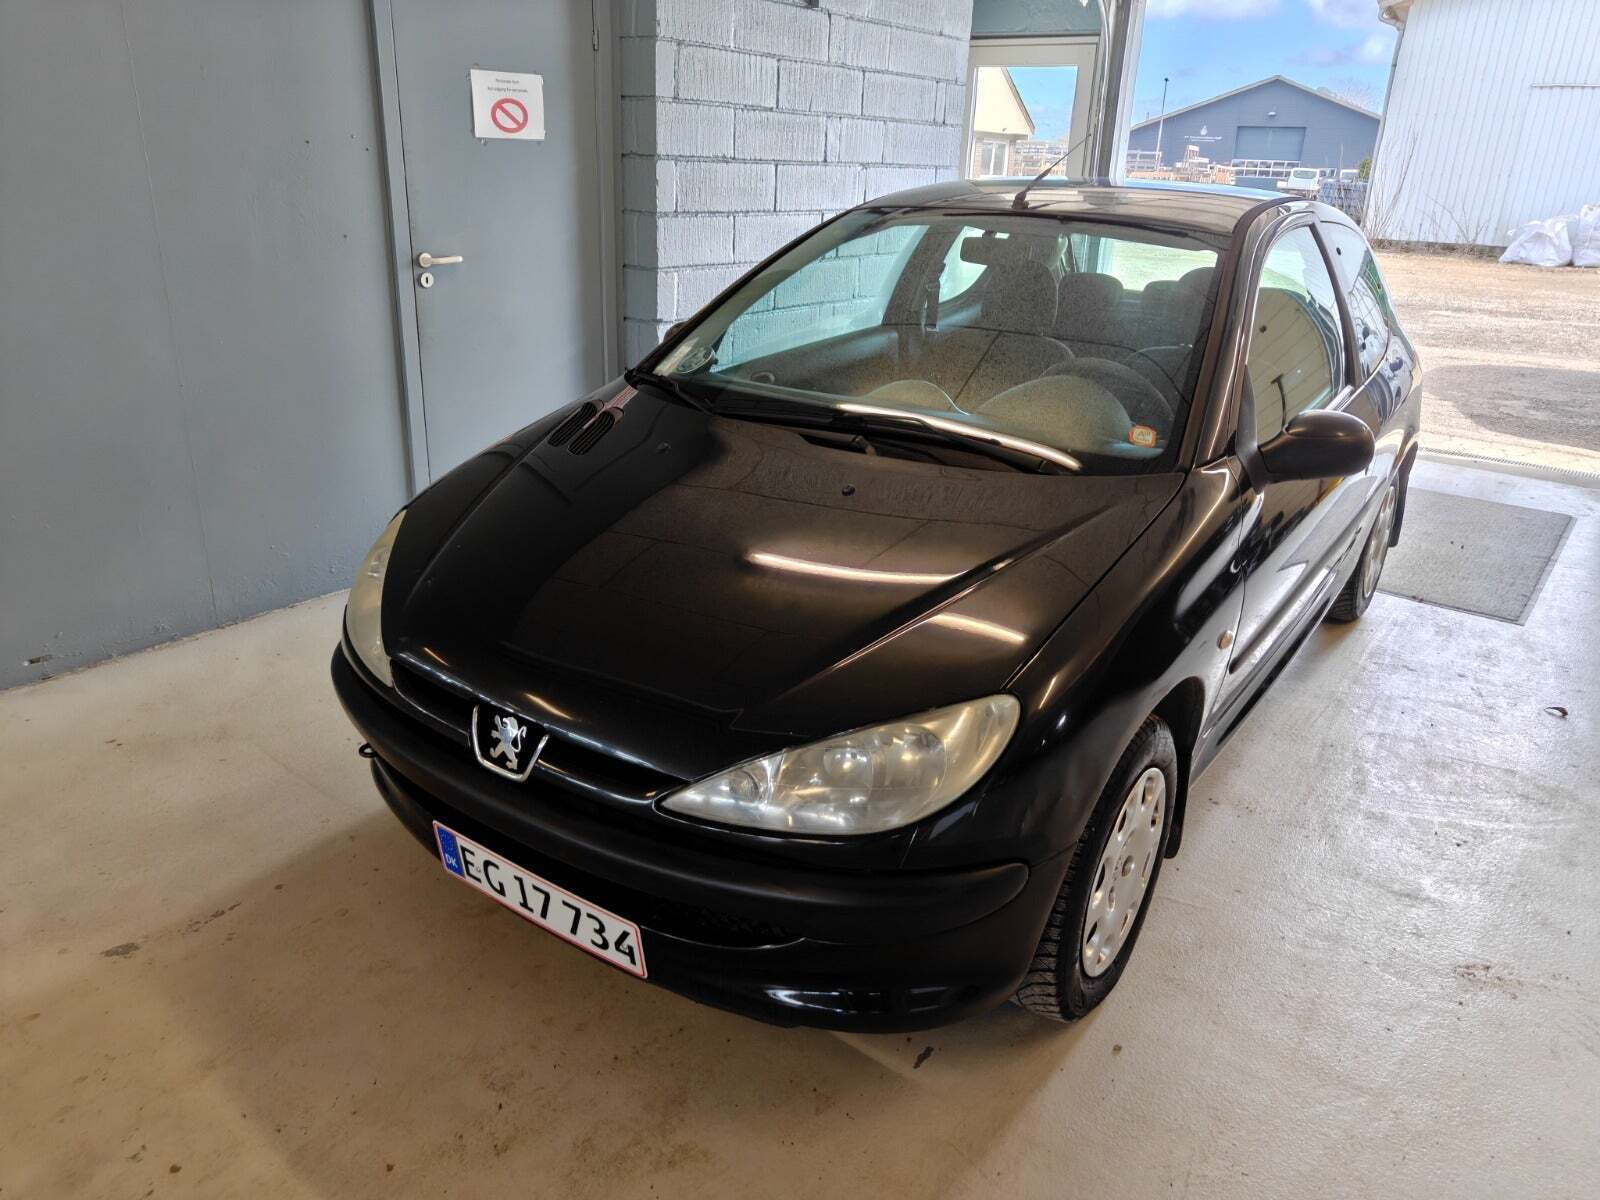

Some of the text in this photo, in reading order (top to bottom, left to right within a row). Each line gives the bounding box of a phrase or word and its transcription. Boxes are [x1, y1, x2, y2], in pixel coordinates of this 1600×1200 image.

[446, 854, 458, 868] DK
[460, 845, 637, 966] EG 17 734
